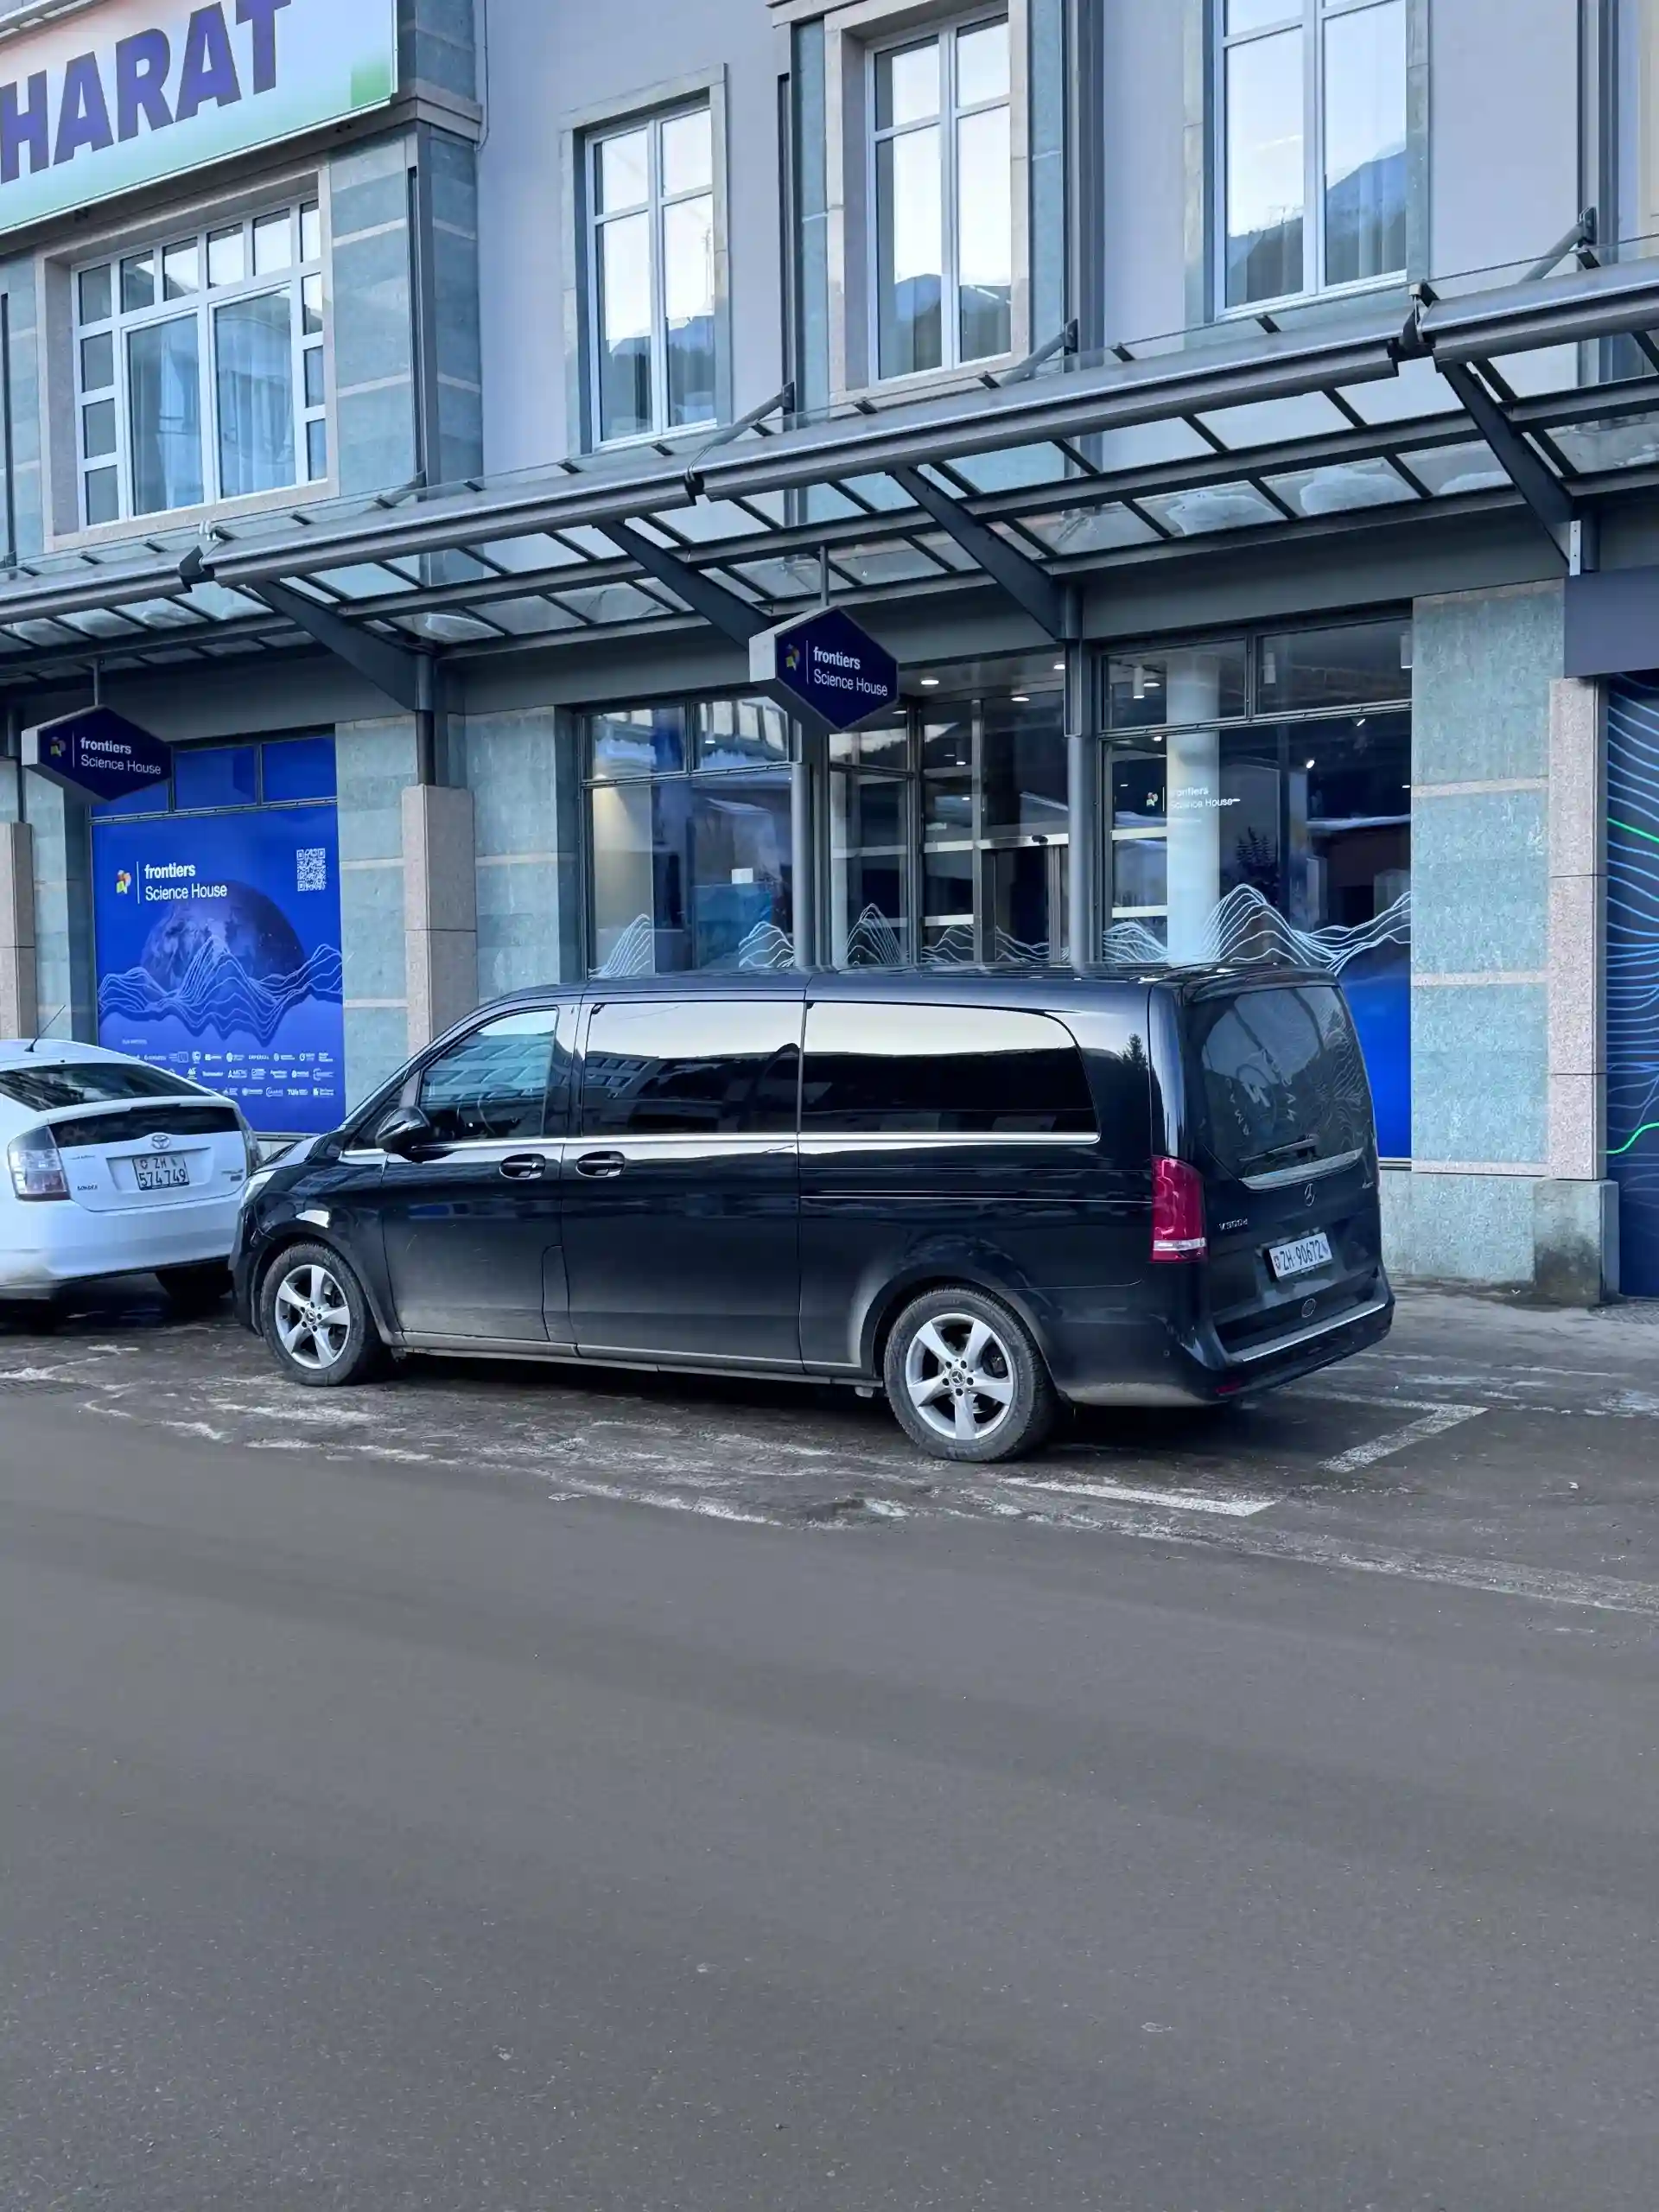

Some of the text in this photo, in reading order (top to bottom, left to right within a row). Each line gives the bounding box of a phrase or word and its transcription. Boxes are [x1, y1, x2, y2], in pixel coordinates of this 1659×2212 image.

[812, 646, 861, 670] frontiers
[813, 668, 888, 696] Science House
[80, 737, 131, 754] frontiers
[81, 753, 162, 775] Science House
[1205, 798, 1233, 807] House
[144, 862, 196, 880] frontiers
[145, 883, 228, 901] Science House
[154, 1158, 167, 1168] ZH
